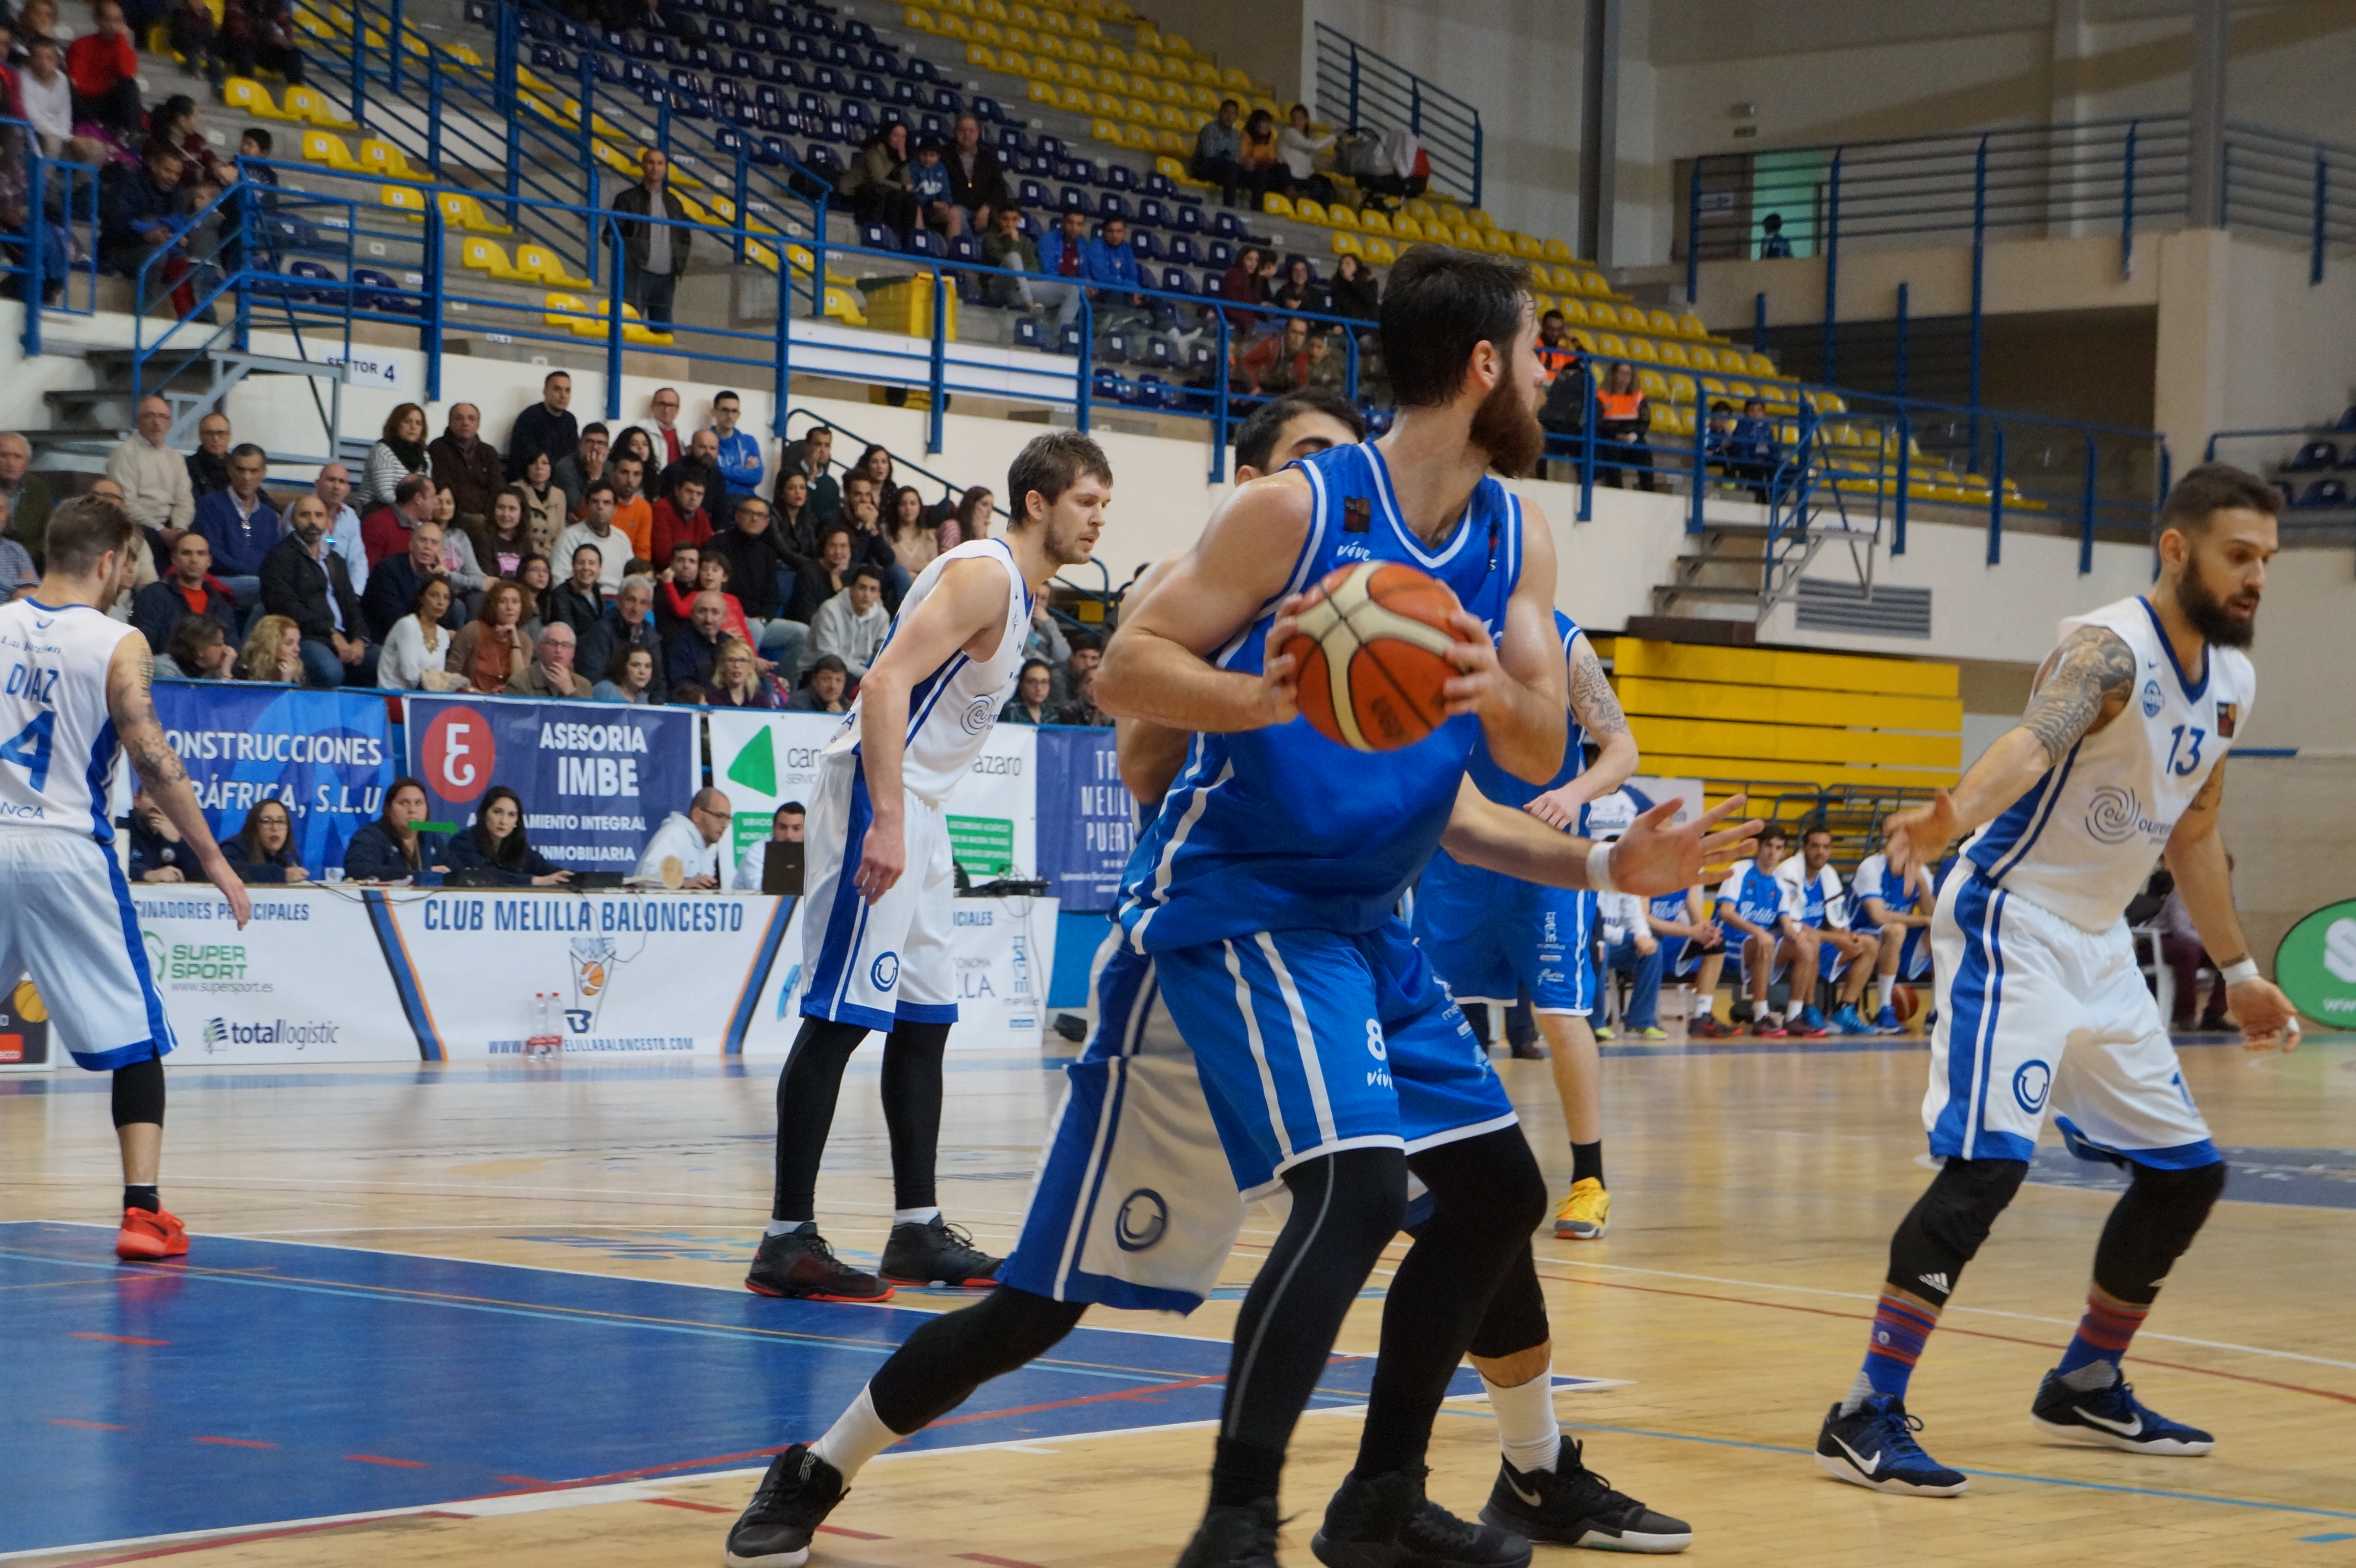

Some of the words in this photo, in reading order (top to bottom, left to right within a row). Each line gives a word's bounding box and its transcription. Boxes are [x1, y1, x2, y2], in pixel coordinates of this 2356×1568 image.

[384, 365, 395, 382] 4
[0, 711, 58, 793] 4
[165, 730, 383, 766] ONSTRUCCIONES
[539, 722, 649, 753] ASESORIA
[2166, 724, 2205, 776] 13
[558, 756, 640, 797] IMBE
[0, 801, 45, 819] NCA
[581, 816, 646, 831] INTEGRAL
[133, 901, 212, 920] CINADORES
[425, 900, 484, 930] CLUB
[495, 901, 591, 931] MELILLA
[602, 902, 743, 932] BALONCESTO
[174, 945, 246, 961] SUPER
[171, 964, 247, 980] SPORT
[231, 1019, 340, 1050] totallogistic
[1366, 1018, 1387, 1061] 8
